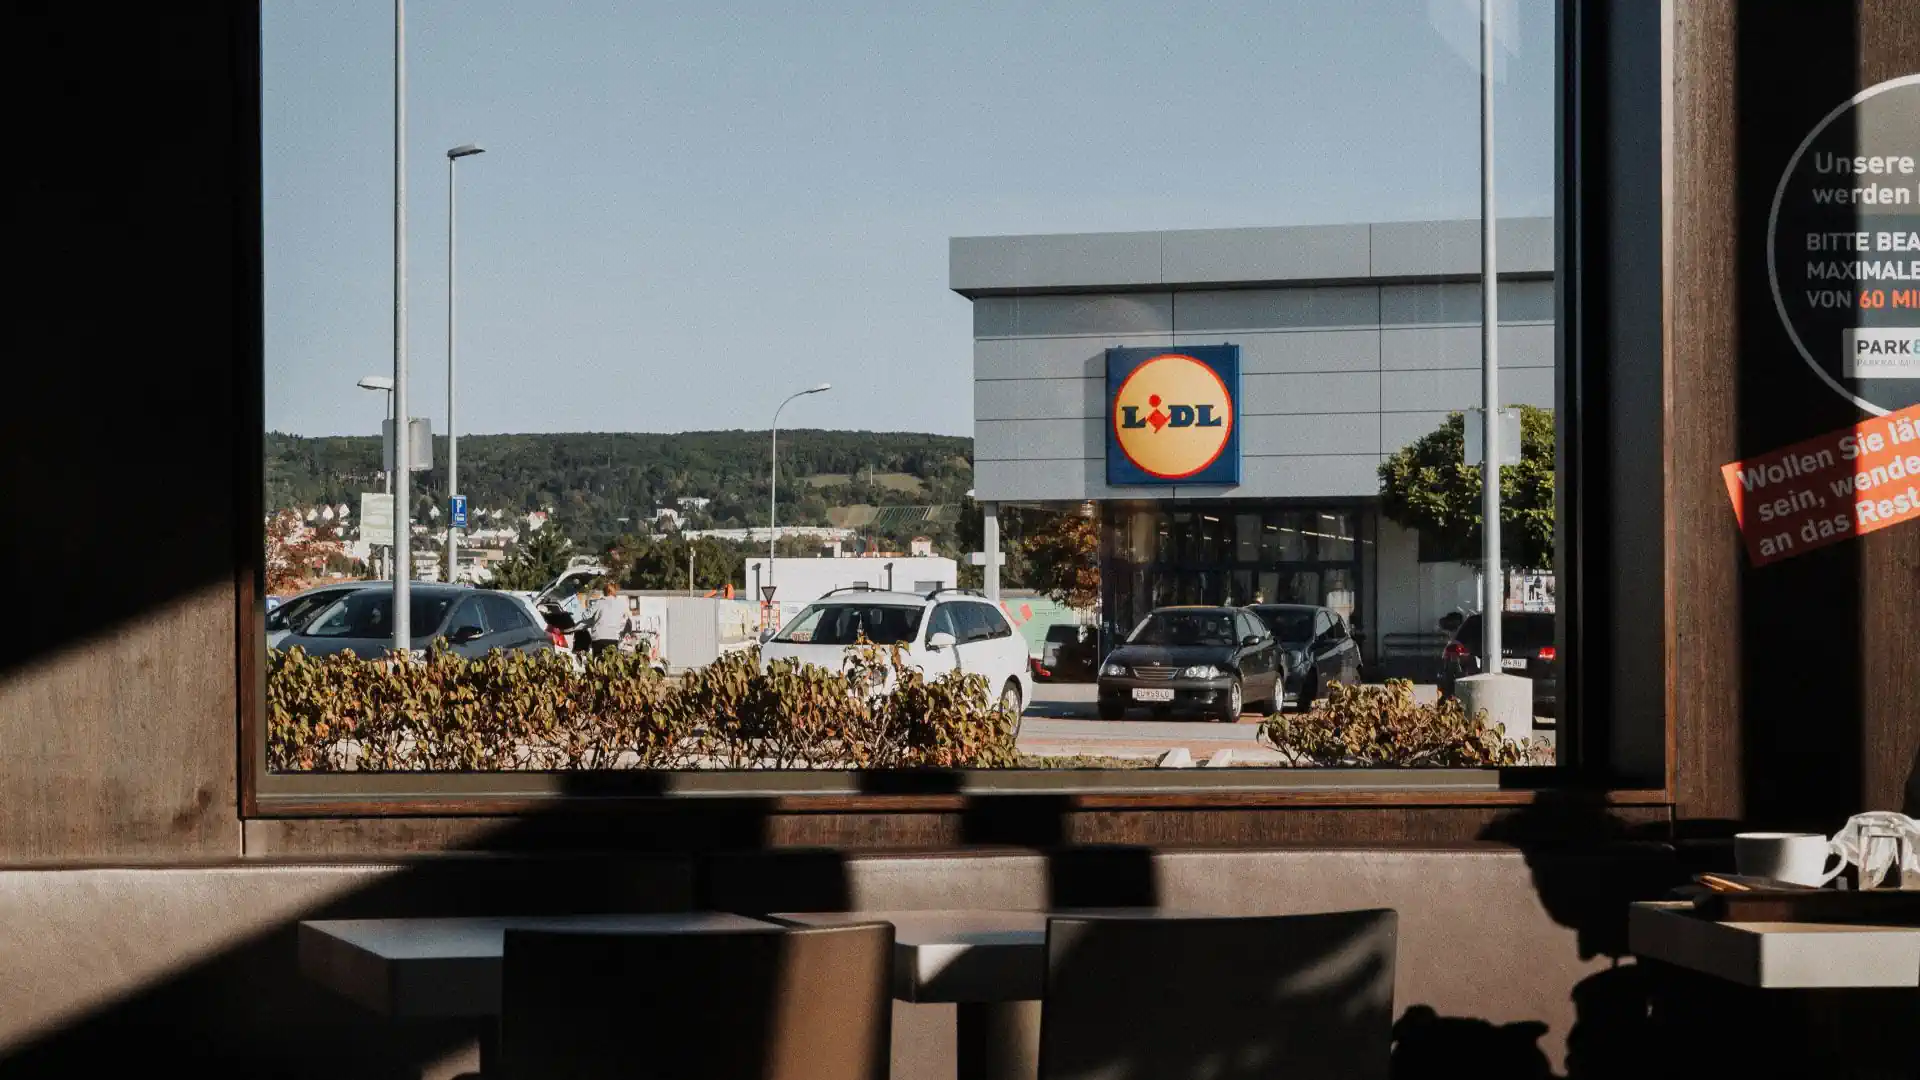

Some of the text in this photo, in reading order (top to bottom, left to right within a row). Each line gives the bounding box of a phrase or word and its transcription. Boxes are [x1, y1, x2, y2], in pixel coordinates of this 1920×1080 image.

[1815, 151, 1915, 174] Unsere
[1812, 182, 1910, 204] werden
[1806, 231, 1870, 251] BITTE
[1806, 289, 1920, 309] VON 60 MI
[1736, 449, 1835, 492] Wollen
[1838, 431, 1885, 460] Sie
[1758, 490, 1826, 522] sein,
[1759, 531, 1794, 556] an
[1800, 514, 1851, 543] das
